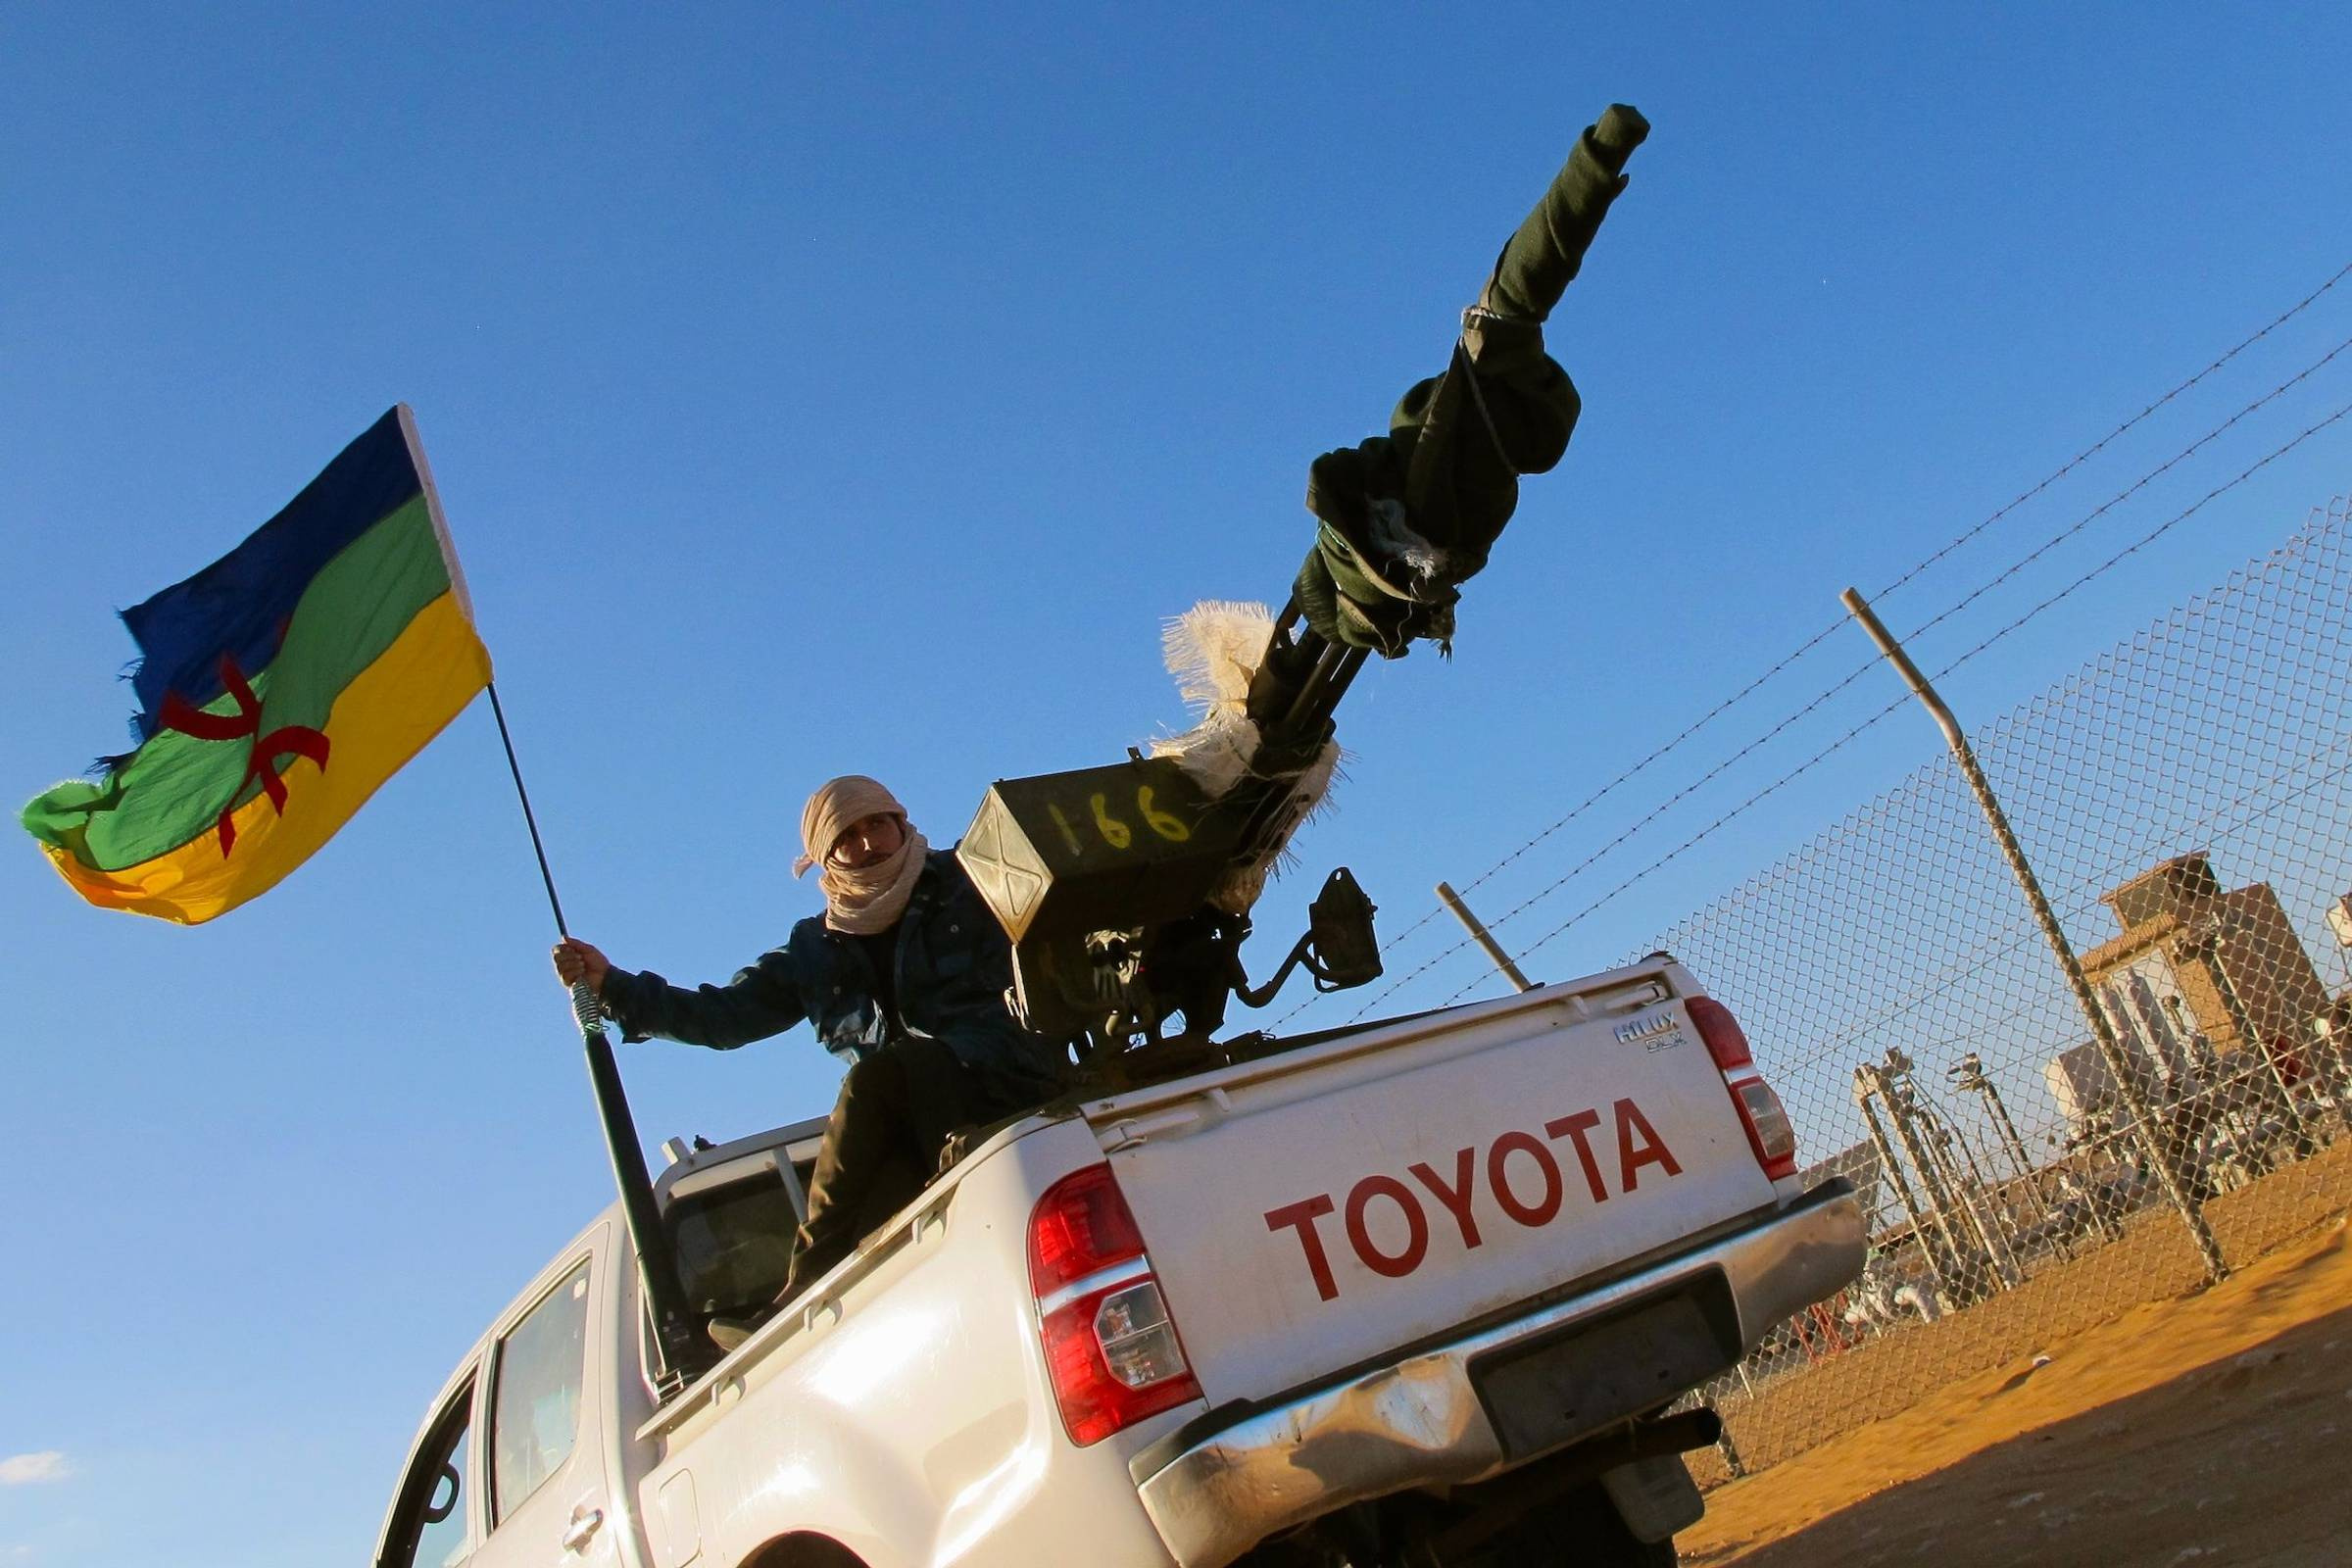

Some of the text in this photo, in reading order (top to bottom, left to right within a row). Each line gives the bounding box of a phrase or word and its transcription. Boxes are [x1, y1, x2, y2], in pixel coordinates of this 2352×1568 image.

[1048, 786, 1191, 857] 166
[1613, 1012, 1679, 1044] HILUX
[1264, 1098, 1683, 1301] TOYOTA
